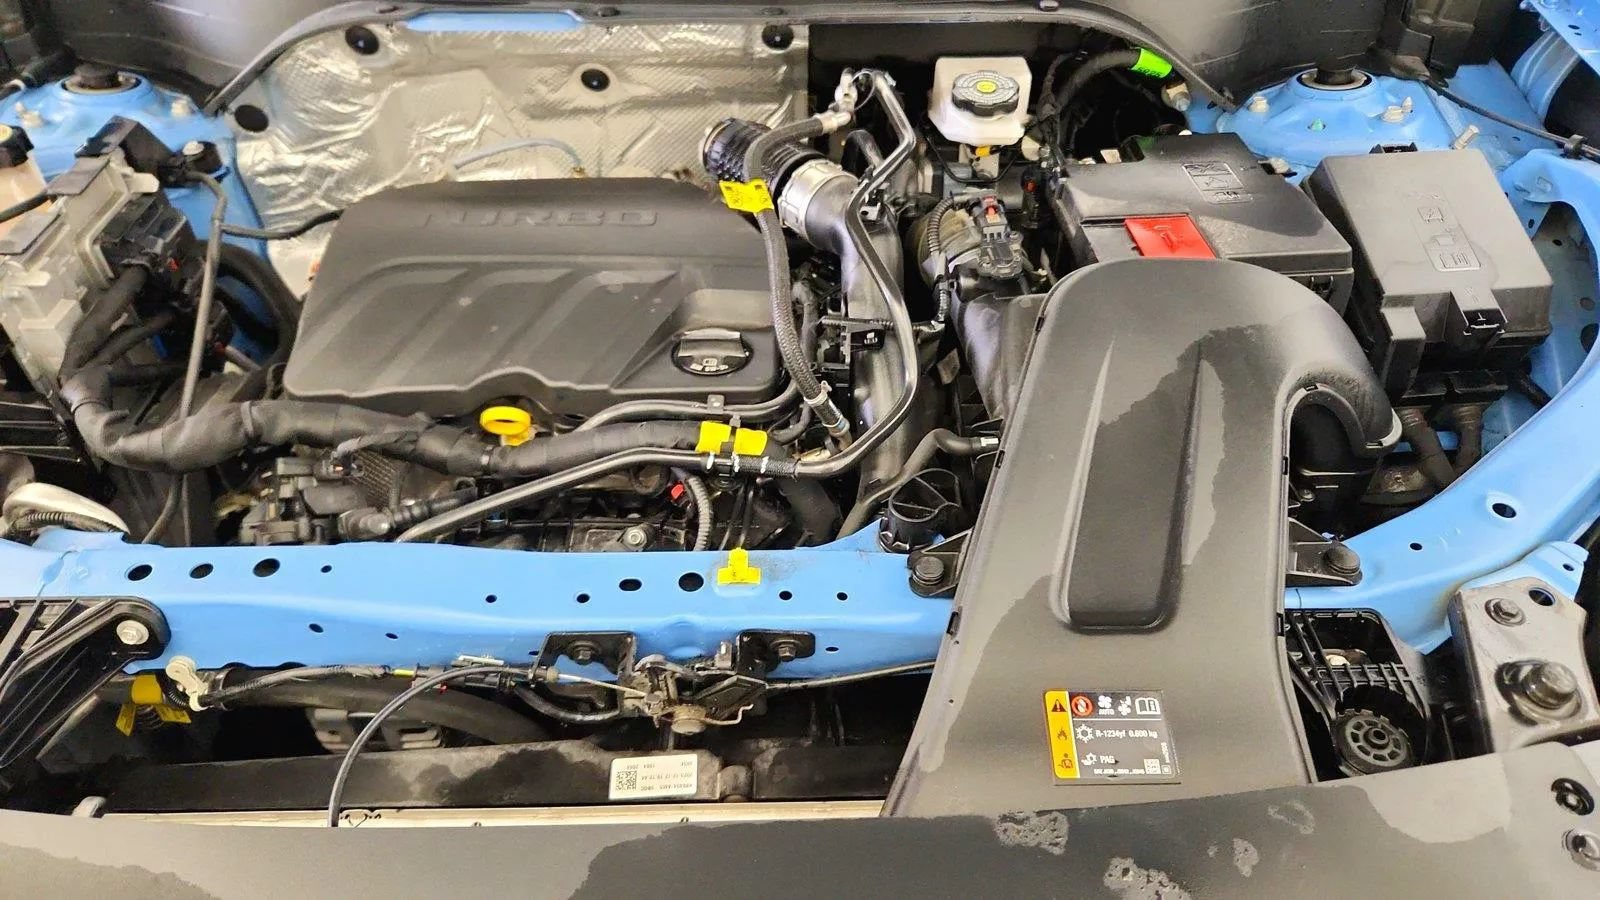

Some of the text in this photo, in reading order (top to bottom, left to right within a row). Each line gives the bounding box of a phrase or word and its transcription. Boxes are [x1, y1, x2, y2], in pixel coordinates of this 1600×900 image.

[410, 209, 658, 228] TURBO
[1095, 729, 1126, 738] R-1234yf
[1099, 755, 1115, 764] PAG
